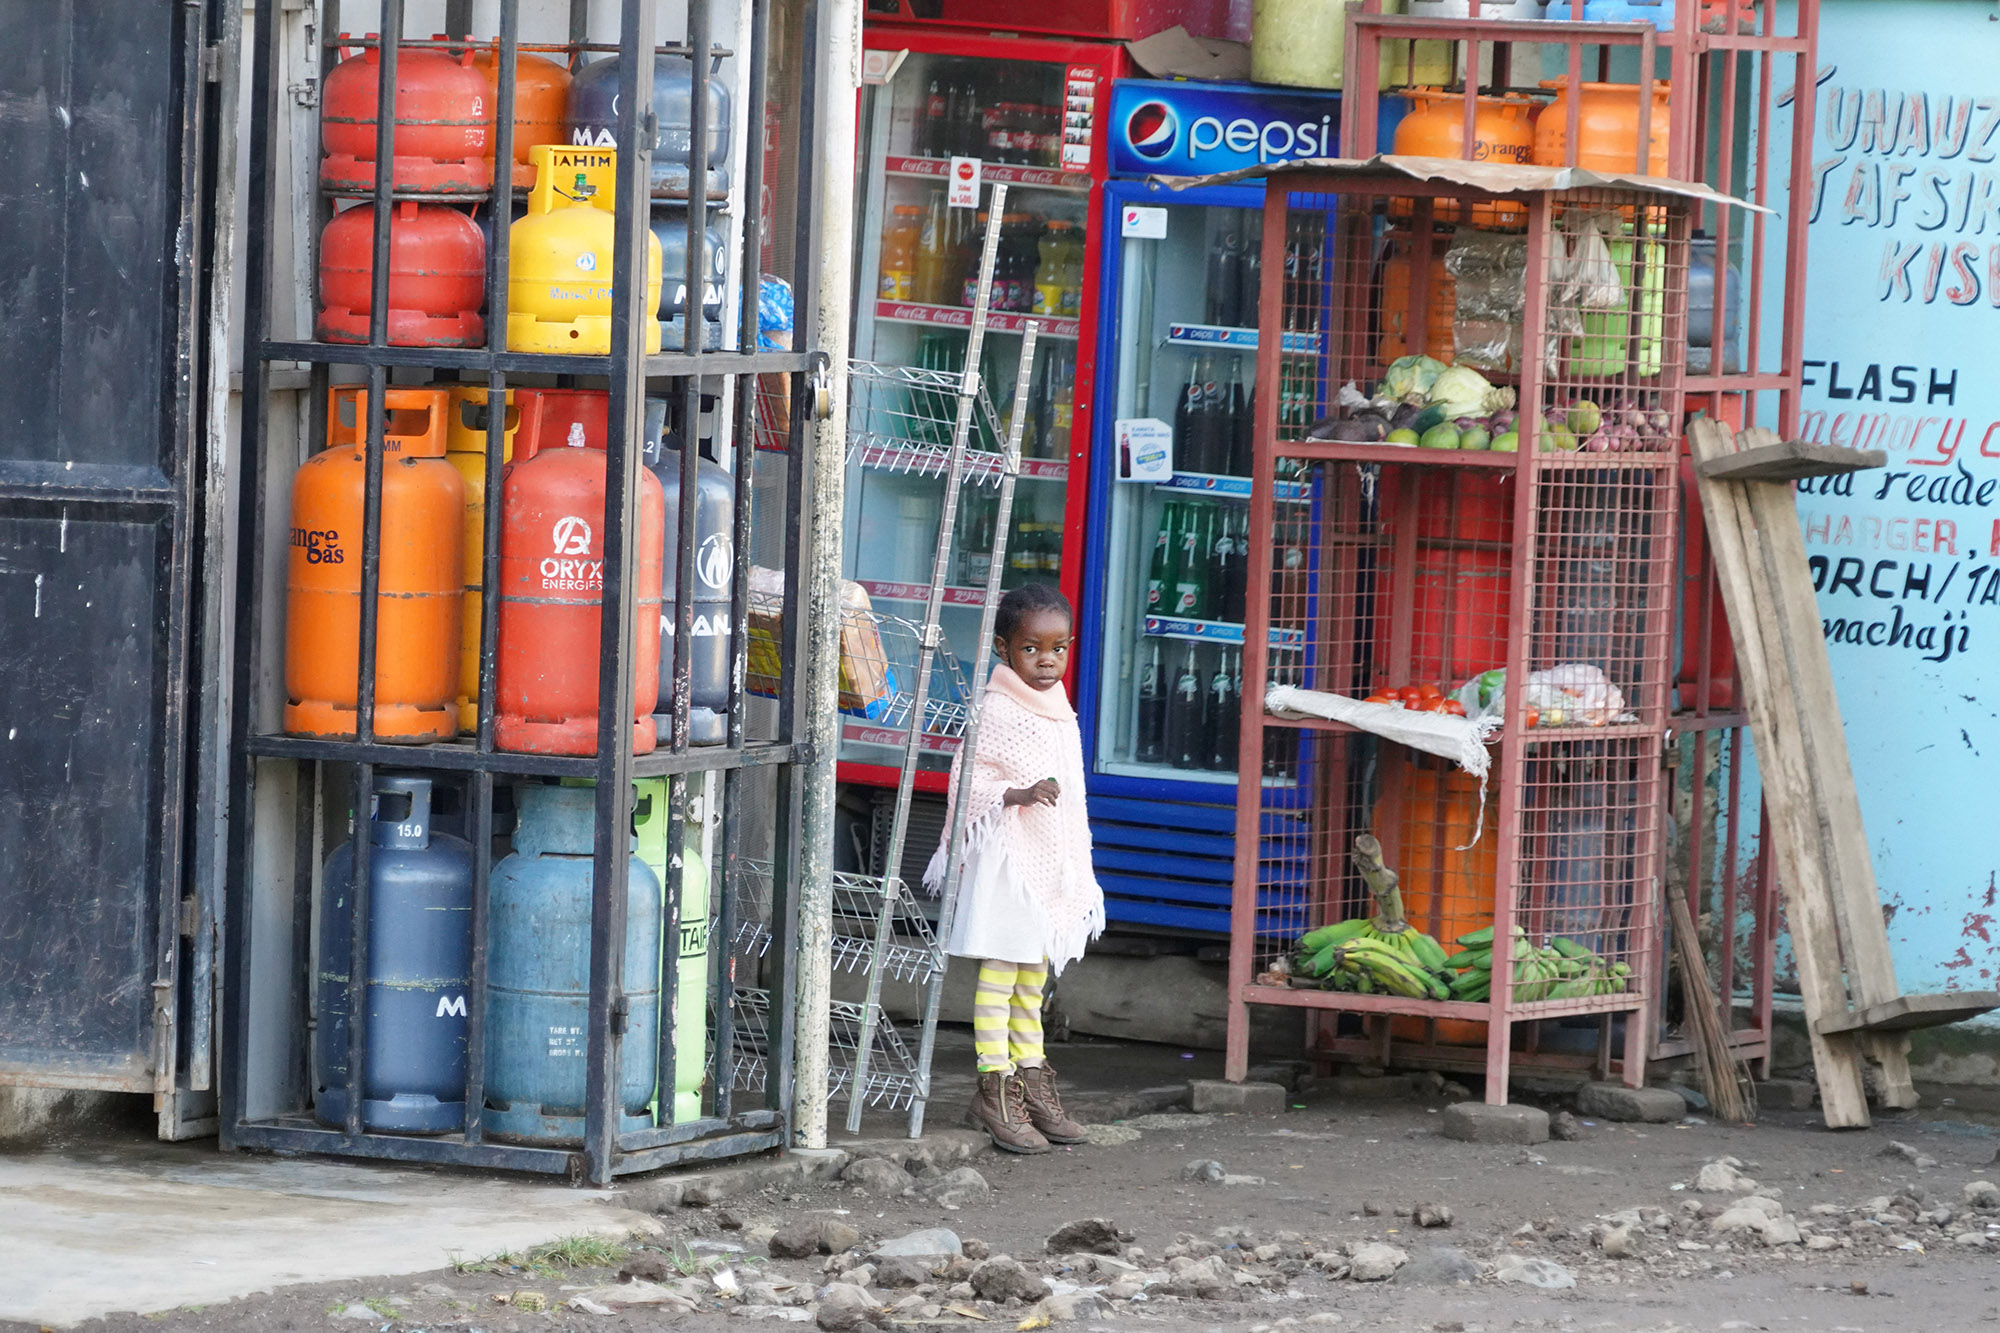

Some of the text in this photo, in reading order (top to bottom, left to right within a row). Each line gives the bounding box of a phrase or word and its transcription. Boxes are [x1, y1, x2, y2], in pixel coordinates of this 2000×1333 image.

[1188, 114, 1331, 164] pepsi
[1802, 361, 1958, 406] FLASH
[540, 558, 603, 579] ORYX
[397, 824, 423, 838] 15.0
